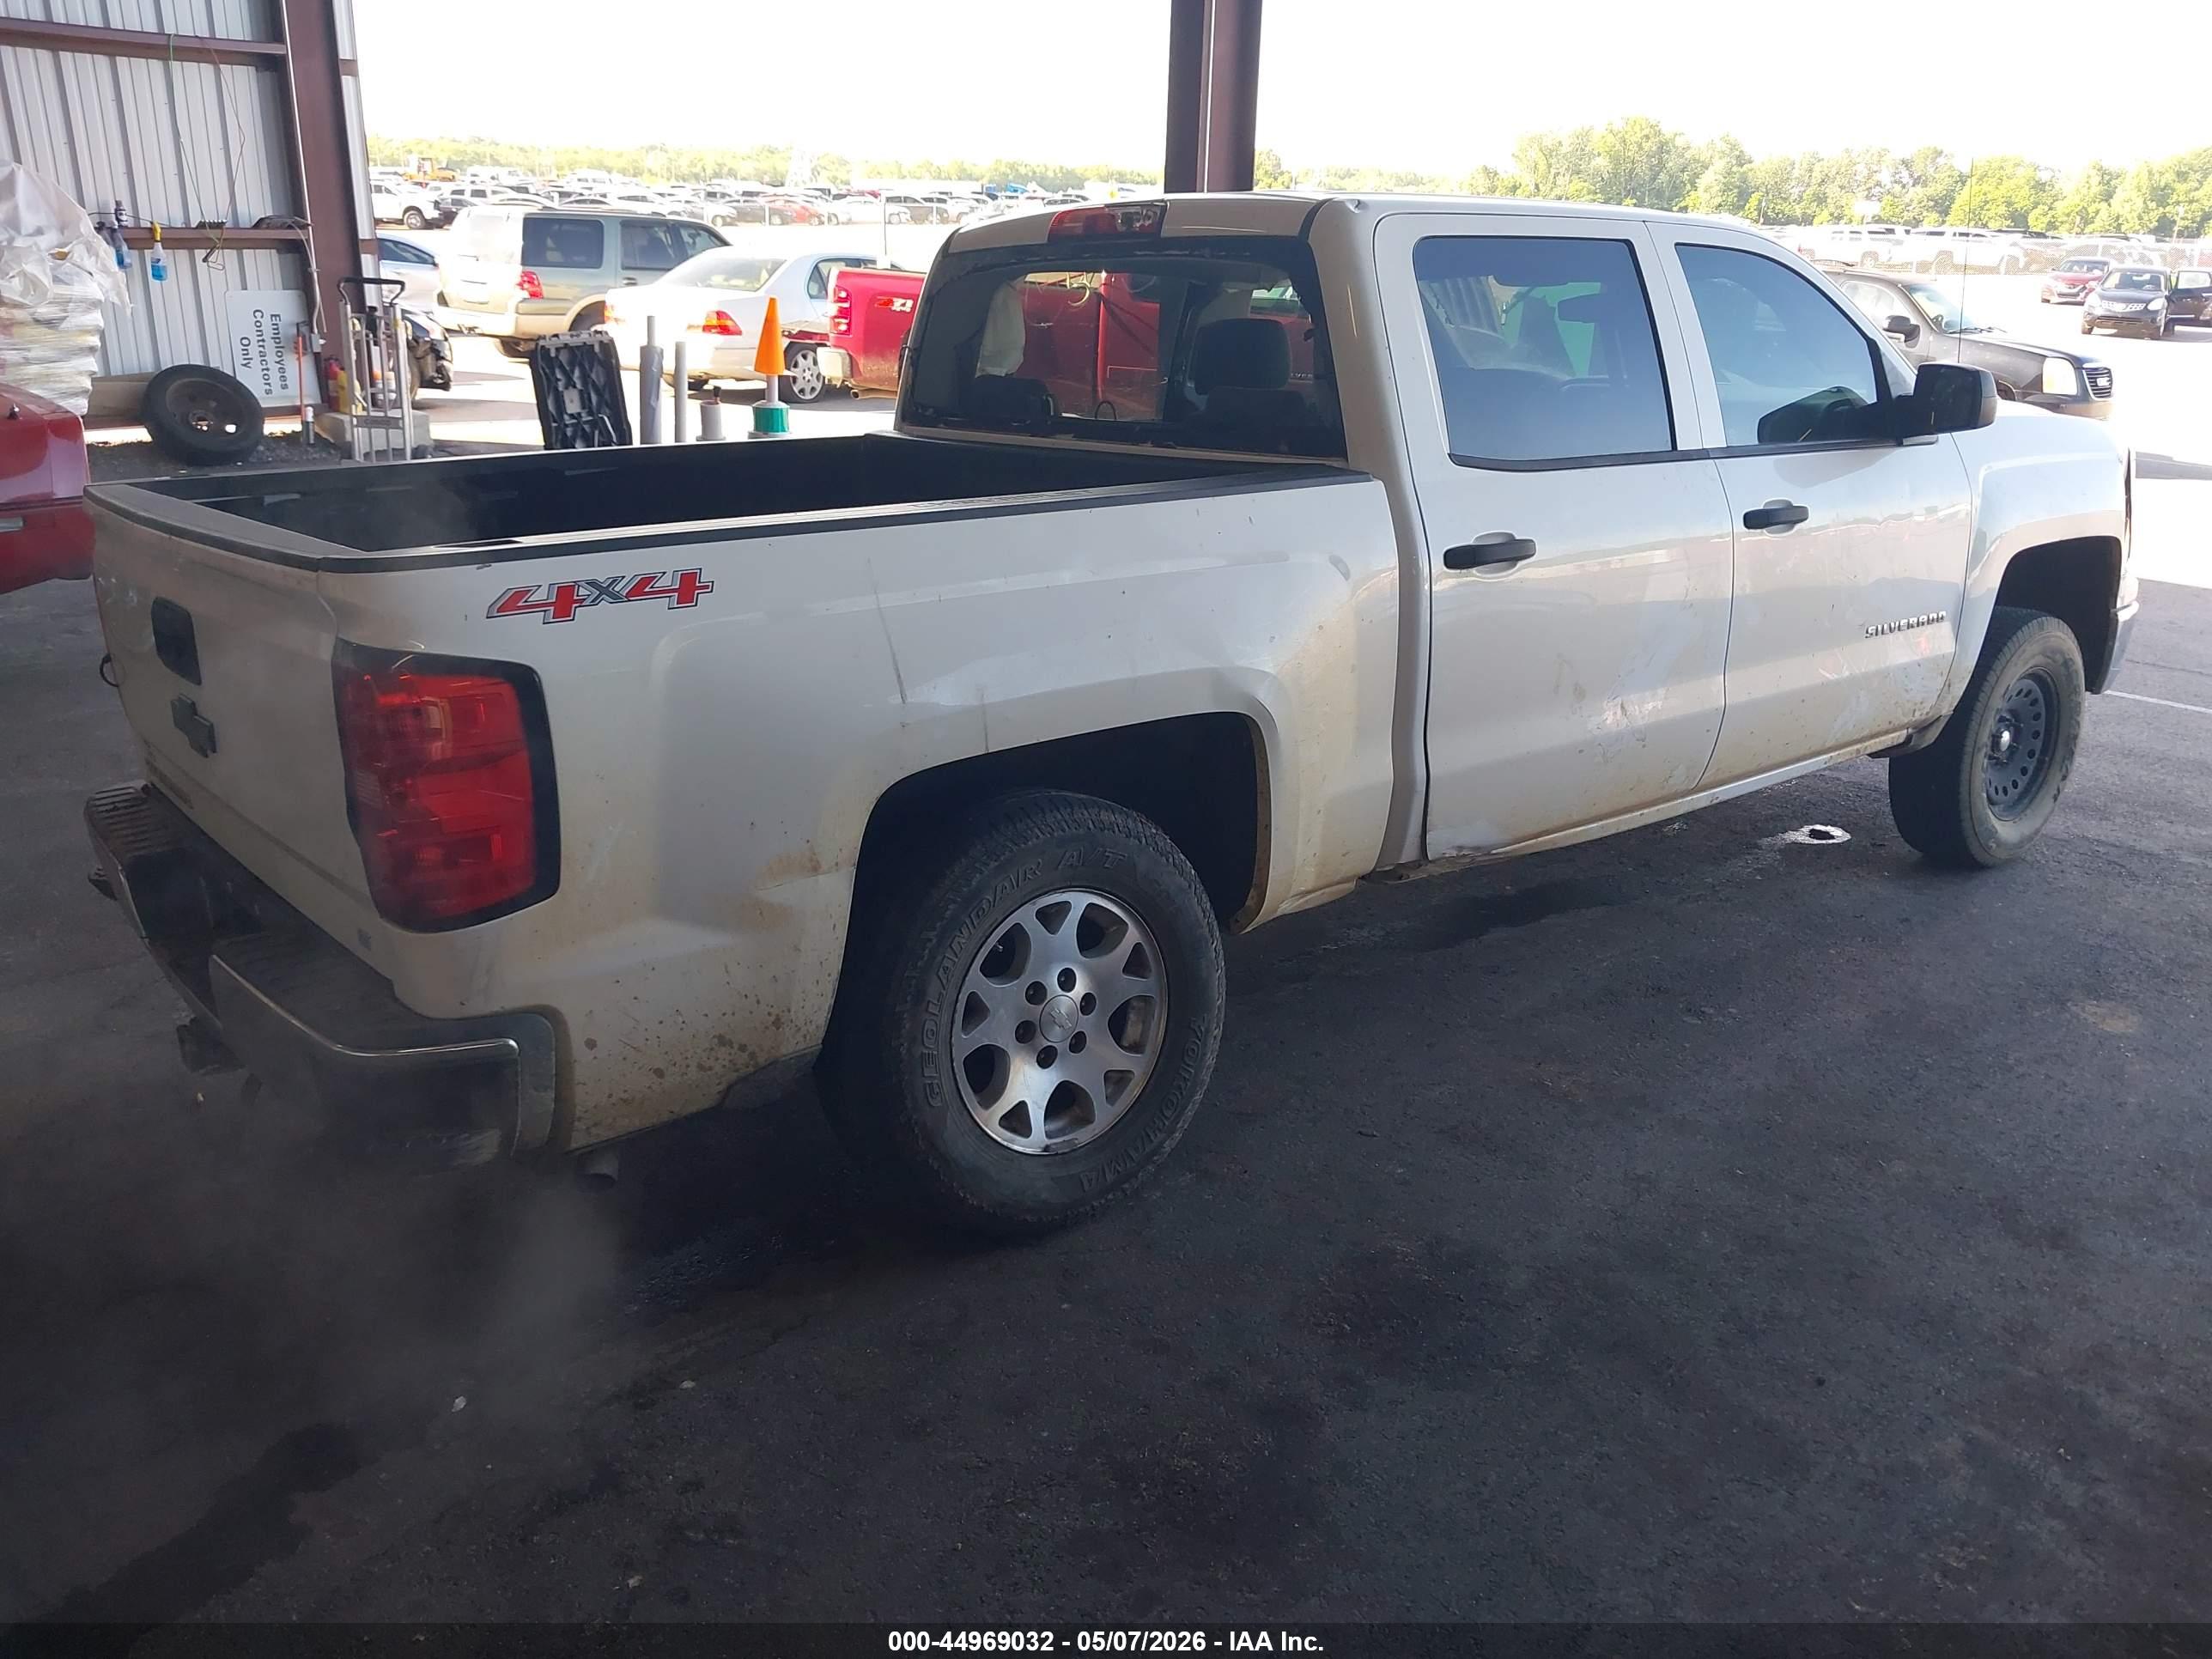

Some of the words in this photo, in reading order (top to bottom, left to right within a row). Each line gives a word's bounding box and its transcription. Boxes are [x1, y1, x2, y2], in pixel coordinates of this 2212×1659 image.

[240, 337, 253, 368] Only
[253, 309, 273, 395] Contractors
[270, 313, 289, 390] Employees
[1864, 611, 1947, 638] SILVERADO
[921, 860, 1042, 1107] GEOLANDAR
[1057, 848, 1127, 869] A/T
[1080, 1014, 1207, 1193] YOKOHAMA
